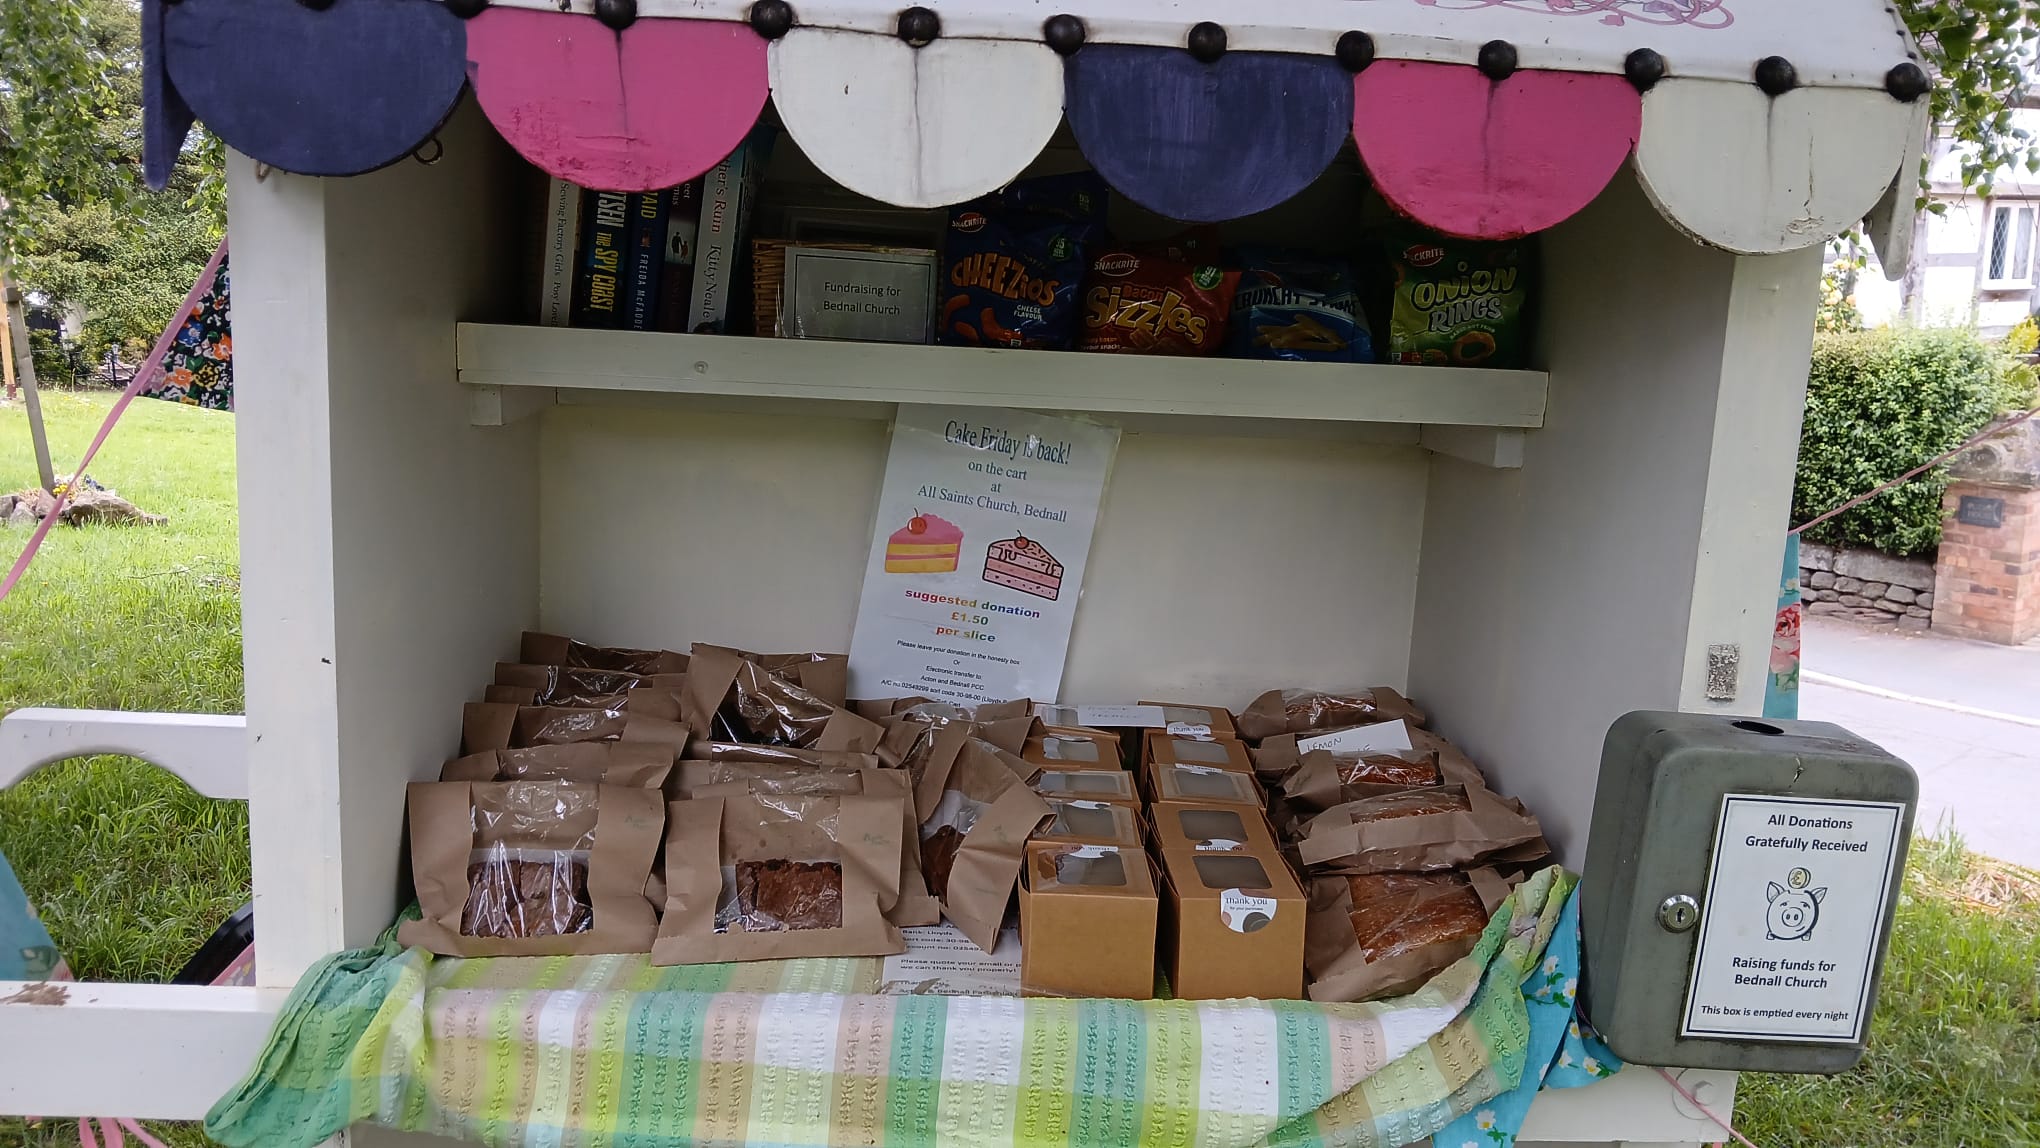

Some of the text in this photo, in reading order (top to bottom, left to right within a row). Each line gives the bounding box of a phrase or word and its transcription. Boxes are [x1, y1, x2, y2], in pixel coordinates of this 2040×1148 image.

[711, 160, 732, 233] ther's Ruin
[596, 192, 627, 228] TSEN
[553, 182, 569, 276] Sewing Factory Girls
[593, 248, 619, 273] SPY
[1402, 247, 1445, 261] SCKRITE
[1093, 259, 1141, 272] SNACKRITE
[702, 244, 722, 319] Kitty Neale
[824, 281, 901, 297] Fundraising for
[1121, 284, 1165, 301] Bacon
[633, 289, 646, 329] McFADDE
[823, 301, 900, 315] Bednall Church
[1013, 310, 1042, 320] FLAVOUR
[1016, 304, 1041, 314] CHEESE
[1085, 285, 1208, 344] Sizzles
[1429, 297, 1502, 332] RINGS
[944, 420, 1072, 465] Cake Friday is back!
[968, 461, 1027, 481] on the cart
[990, 482, 1002, 493] at
[917, 485, 1068, 523] All Saints Church, Bednall
[905, 589, 1041, 618] suggested donation
[951, 611, 989, 625] £1.50
[936, 626, 996, 642] per slice
[897, 640, 916, 649] Please
[917, 643, 933, 651] leave
[946, 648, 970, 658] donation
[987, 655, 1009, 664] honesty
[925, 665, 953, 676] Electronic
[954, 670, 976, 679] transfer
[920, 675, 937, 683] Acton
[949, 680, 970, 689] Bednall
[970, 682, 985, 691] PCC
[941, 689, 955, 697] code
[1767, 813, 1853, 830] All Donations
[1745, 835, 1868, 853] Gratefully Received
[1225, 896, 1268, 907] thank you
[1732, 957, 1836, 973] Raising funds for
[1734, 973, 1828, 989] Bednall Church
[1701, 1005, 1849, 1022] This box is emptied every night
